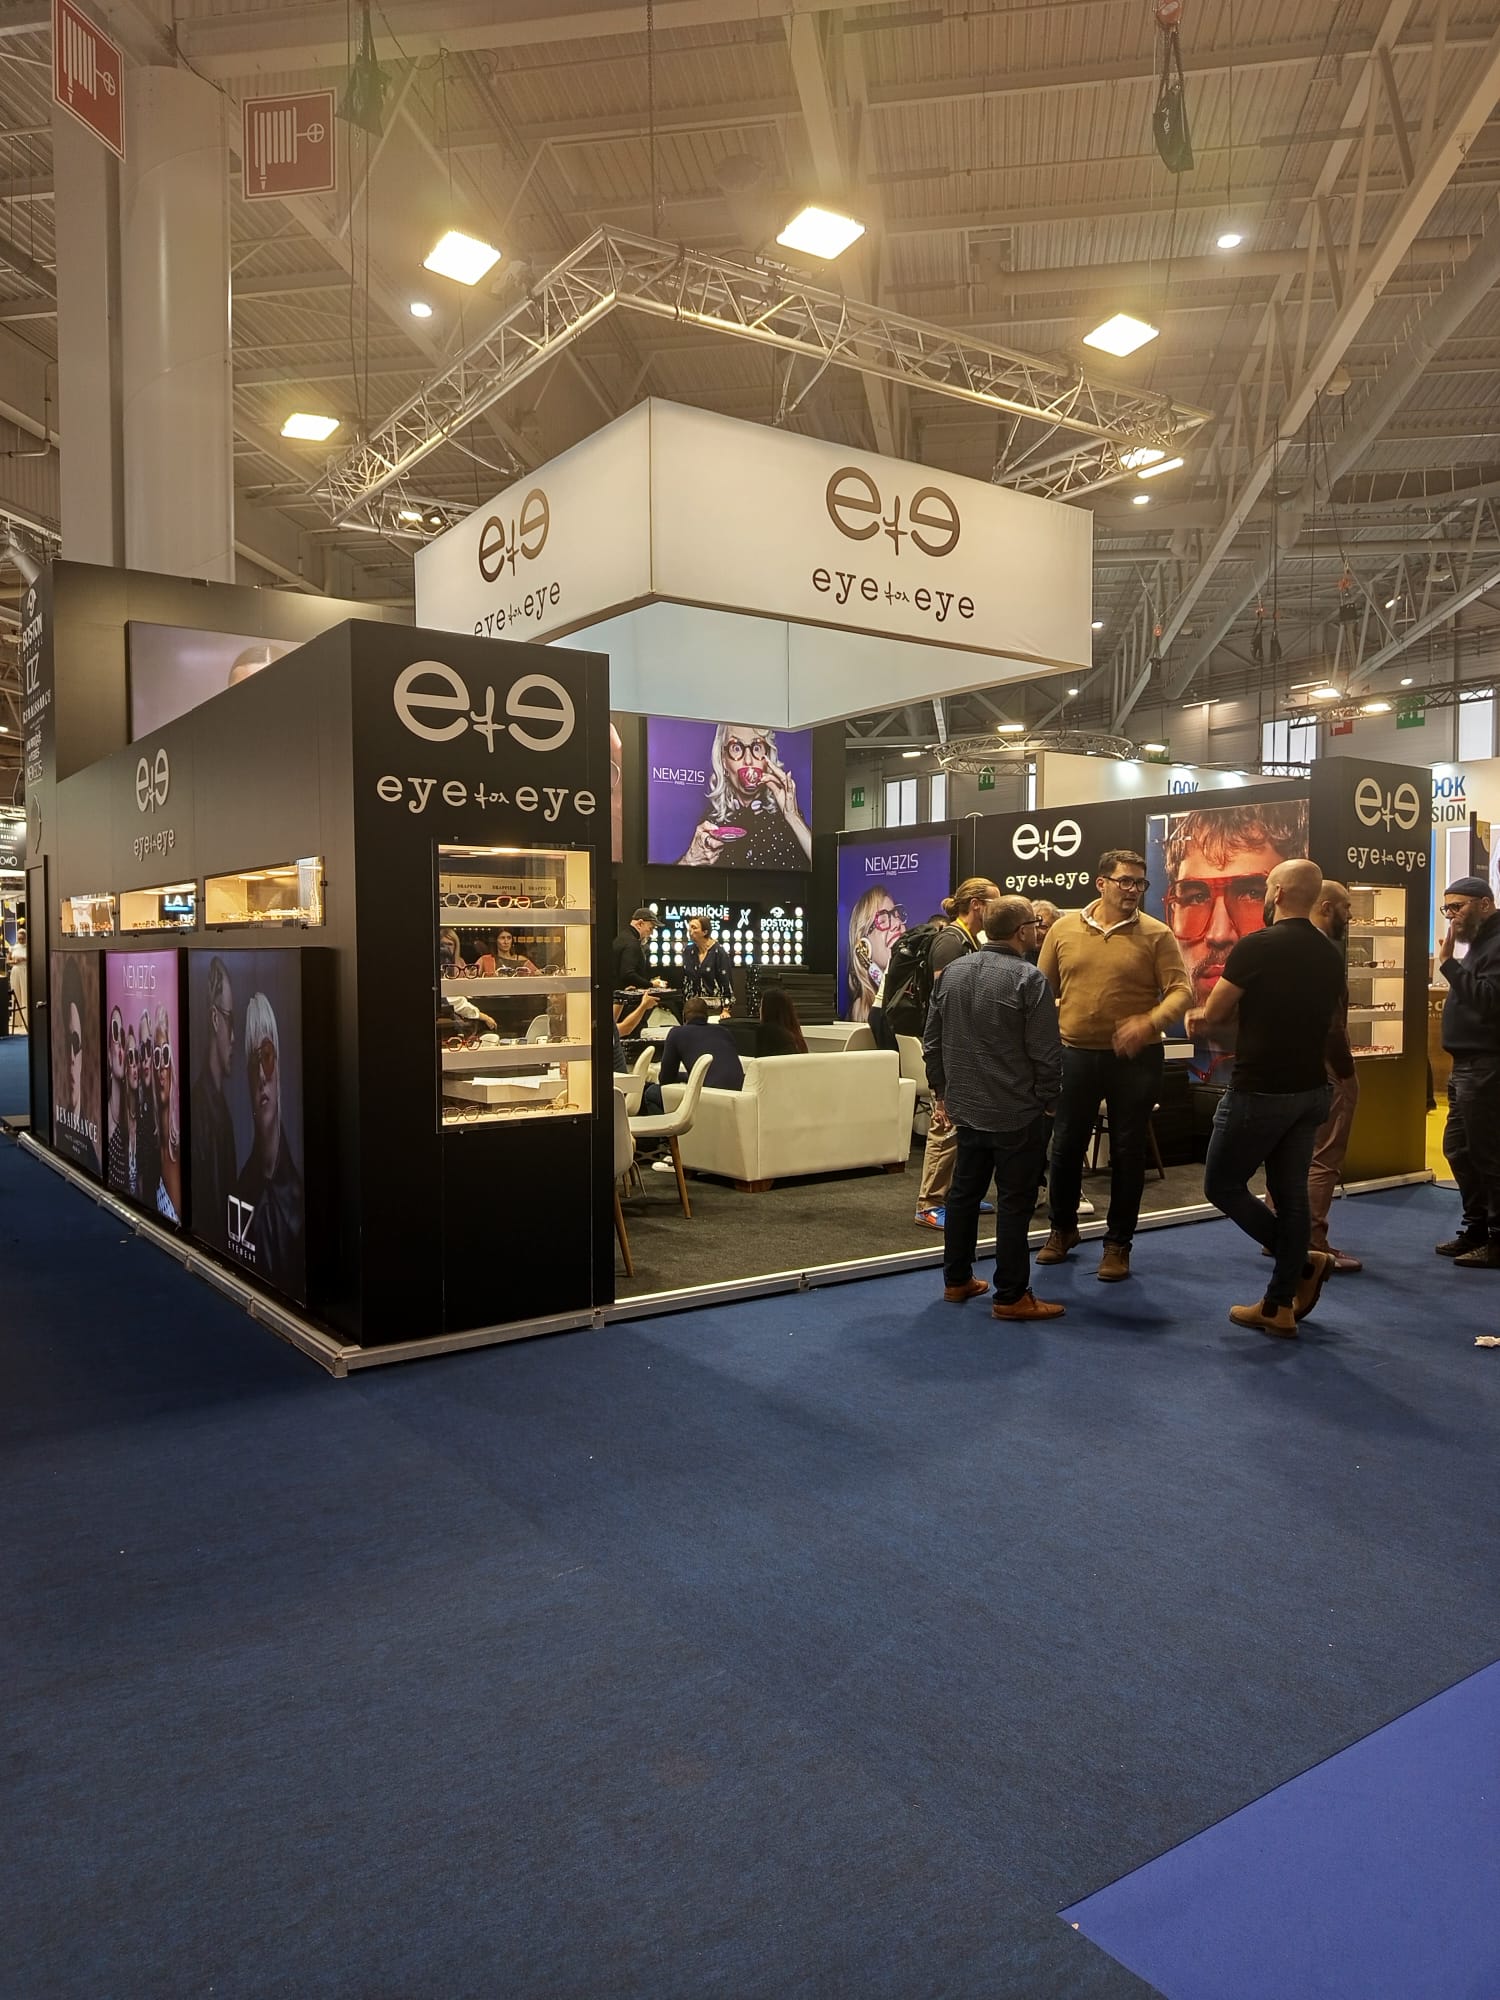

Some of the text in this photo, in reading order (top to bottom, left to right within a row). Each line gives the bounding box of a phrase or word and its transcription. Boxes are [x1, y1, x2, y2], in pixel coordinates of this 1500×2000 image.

[507, 603, 523, 627] for
[523, 582, 560, 621] eye
[812, 568, 974, 622] eye for eye
[376, 775, 596, 822] eye for eye
[1431, 803, 1466, 823] SION
[134, 835, 150, 861] eye
[156, 829, 175, 856] eye
[1347, 846, 1380, 869] eye
[1395, 850, 1426, 872] eye
[1005, 875, 1038, 892] eye
[1054, 872, 1090, 890] eye
[665, 905, 679, 917] LA
[760, 918, 794, 928] BOSTON
[674, 921, 685, 929] DE
[56, 1104, 98, 1143] RENAISSANCE
